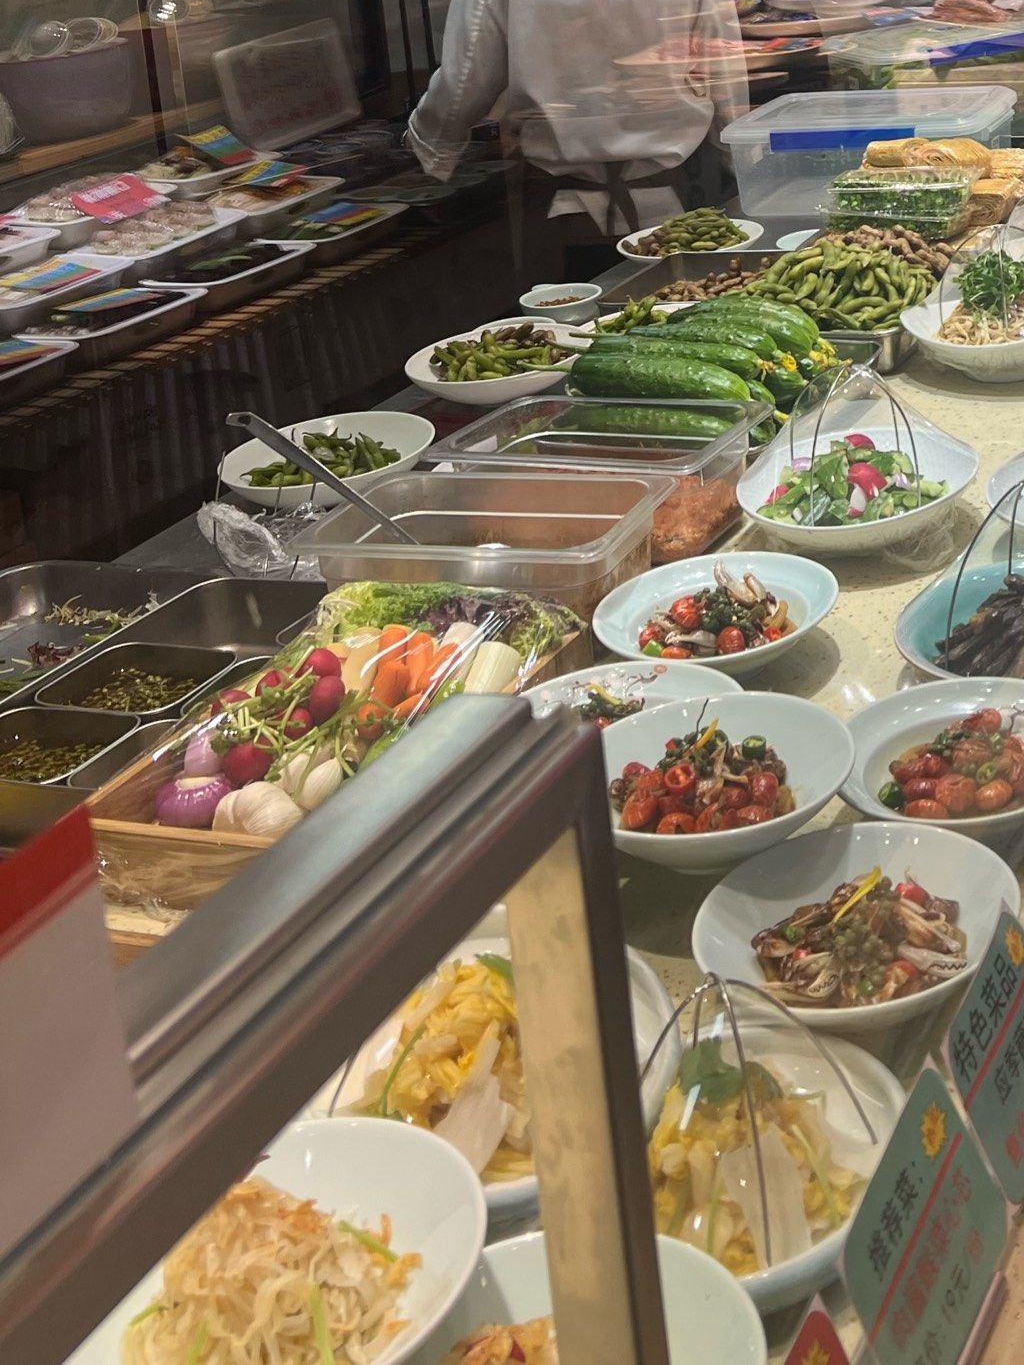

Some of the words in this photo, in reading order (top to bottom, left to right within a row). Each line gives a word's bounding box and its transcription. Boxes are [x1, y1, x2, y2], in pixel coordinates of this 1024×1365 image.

[953, 954, 1018, 1082] 特色菜品
[867, 1159, 924, 1282] 推荐菜:
